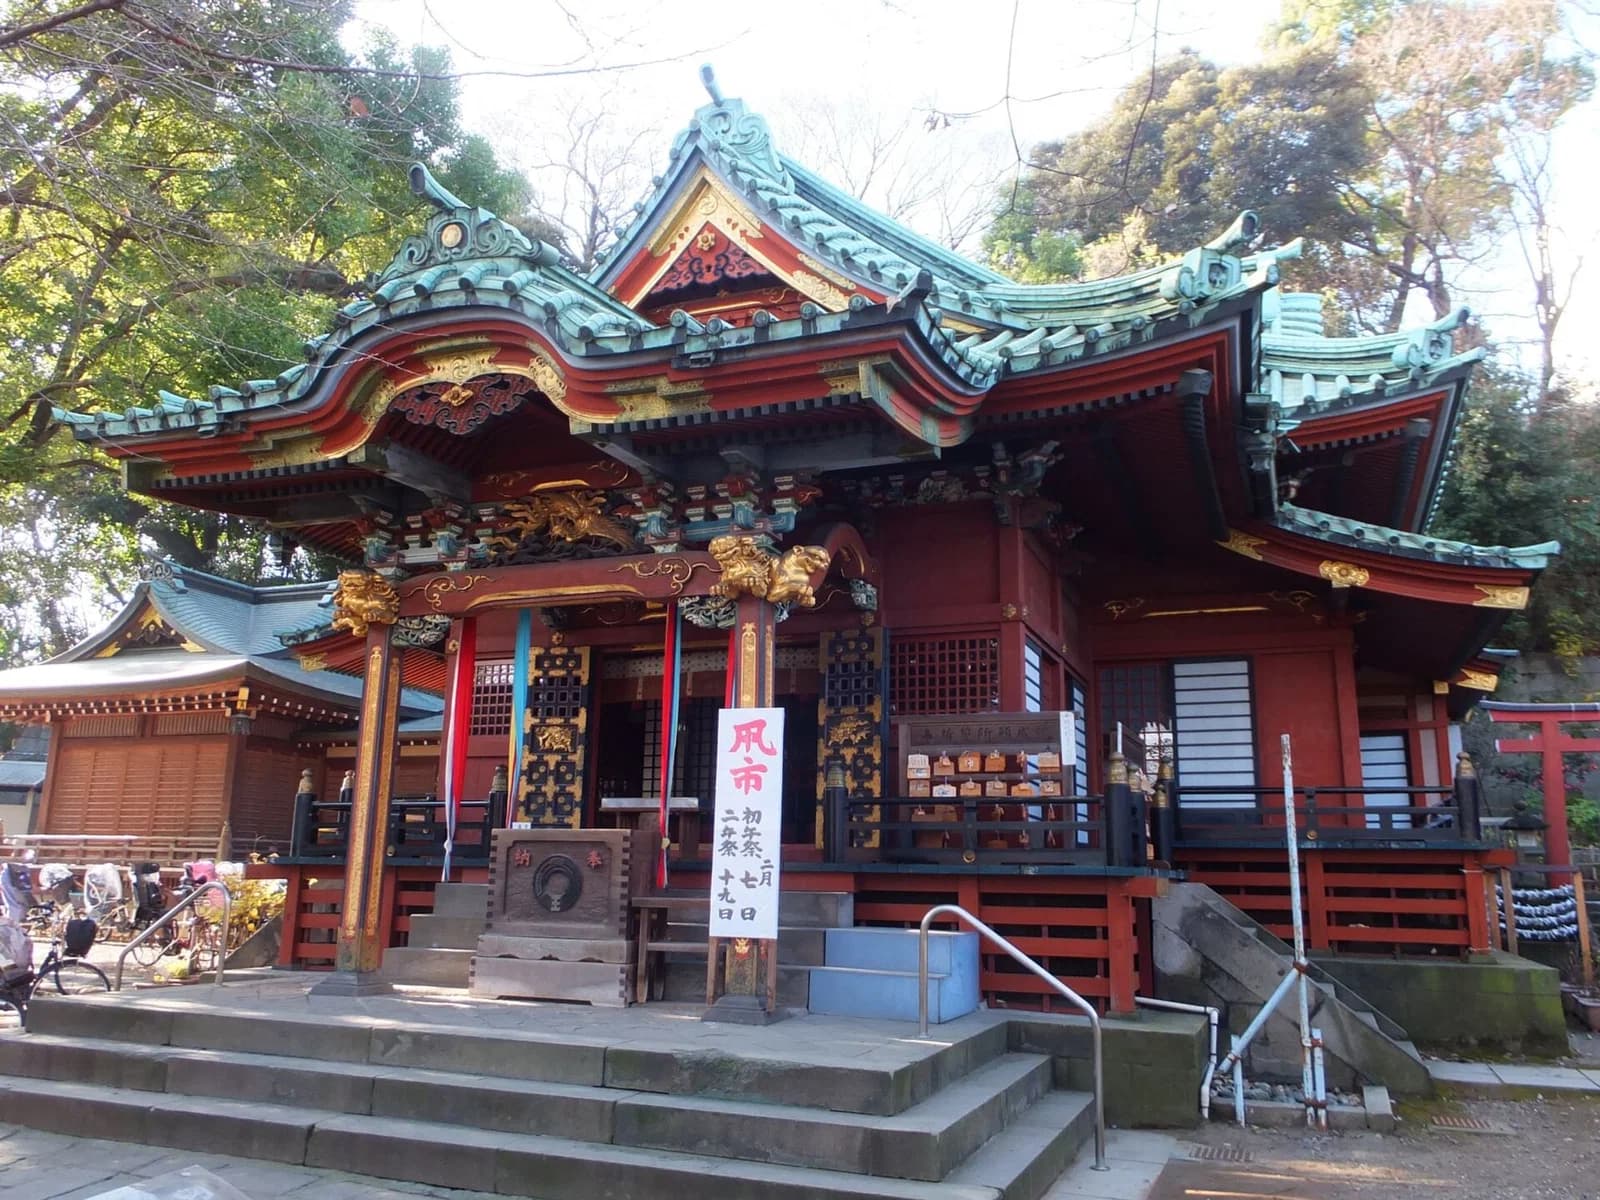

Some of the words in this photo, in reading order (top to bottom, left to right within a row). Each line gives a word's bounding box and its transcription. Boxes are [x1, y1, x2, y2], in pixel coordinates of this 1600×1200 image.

[729, 718, 777, 796] 凧市
[717, 868, 737, 921] 十九日
[759, 857, 775, 887] 二月
